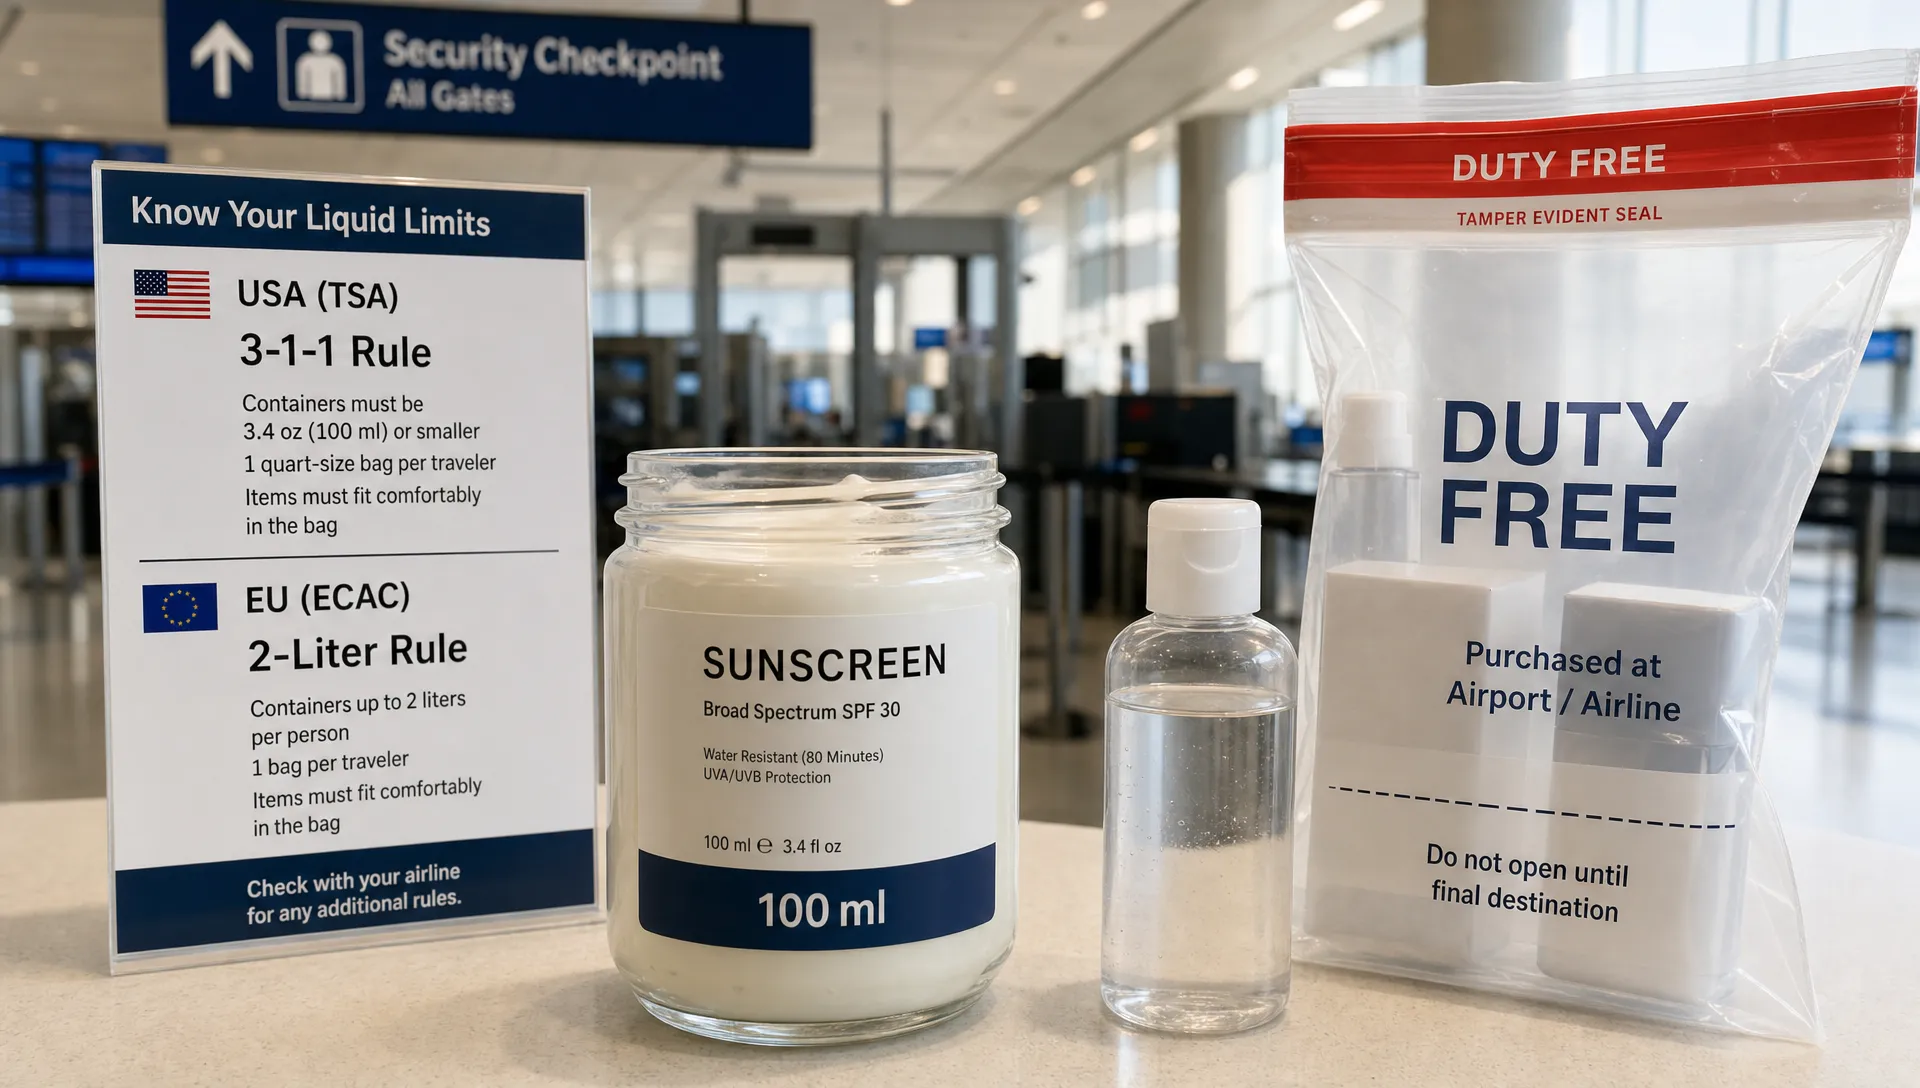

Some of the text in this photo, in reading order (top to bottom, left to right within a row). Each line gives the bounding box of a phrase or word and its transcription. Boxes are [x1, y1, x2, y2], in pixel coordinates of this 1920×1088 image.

[384, 29, 724, 84] Security Checkpoint
[387, 80, 516, 115] All Gates
[1453, 144, 1665, 181] DUTY FREE
[133, 196, 490, 237] Know Your Liquid Limits
[1457, 206, 1662, 225] TAMPER EVIDENT SEAL
[239, 280, 397, 314] USA (TSA)
[241, 333, 431, 367] 3-1-1 Rule
[243, 394, 423, 412] Containers must be
[244, 422, 480, 443] 3.4 oz (100 ml) or smaller
[1443, 401, 1688, 467] DUTY
[245, 454, 496, 476] 1 quart-size bag per traveler
[247, 486, 481, 506] Items must fit comfortably
[247, 516, 337, 537] in the bag
[1441, 479, 1676, 553] FREE
[247, 581, 409, 616] EU (ECAC)
[249, 633, 467, 671] 2-Liter Rule
[704, 643, 945, 682] SUNSCREEN
[1467, 641, 1661, 678] Purchased at
[251, 691, 465, 717] Containers up to 2 liters
[704, 701, 900, 723] Broad Spectrum SPF 30
[1447, 681, 1680, 721] Airport / Airline
[252, 728, 348, 750] per person
[253, 751, 409, 778] 1 bag per traveler
[704, 748, 883, 765] Water Resistant (80 Minutes)
[254, 777, 481, 808] Items must fit comfortably
[704, 768, 830, 783] UVA/UVB Protection
[254, 816, 339, 836] in the bag
[705, 835, 728, 850] 100
[735, 838, 750, 852] ml
[783, 839, 805, 853] 3.4
[811, 839, 819, 853] fl
[825, 843, 841, 853] oz
[248, 864, 460, 897] Check with your airline
[1428, 843, 1628, 887] Do not open until
[247, 889, 461, 924] for any additional rules.
[759, 889, 884, 927] 100 ml
[1432, 879, 1618, 922] final destination
